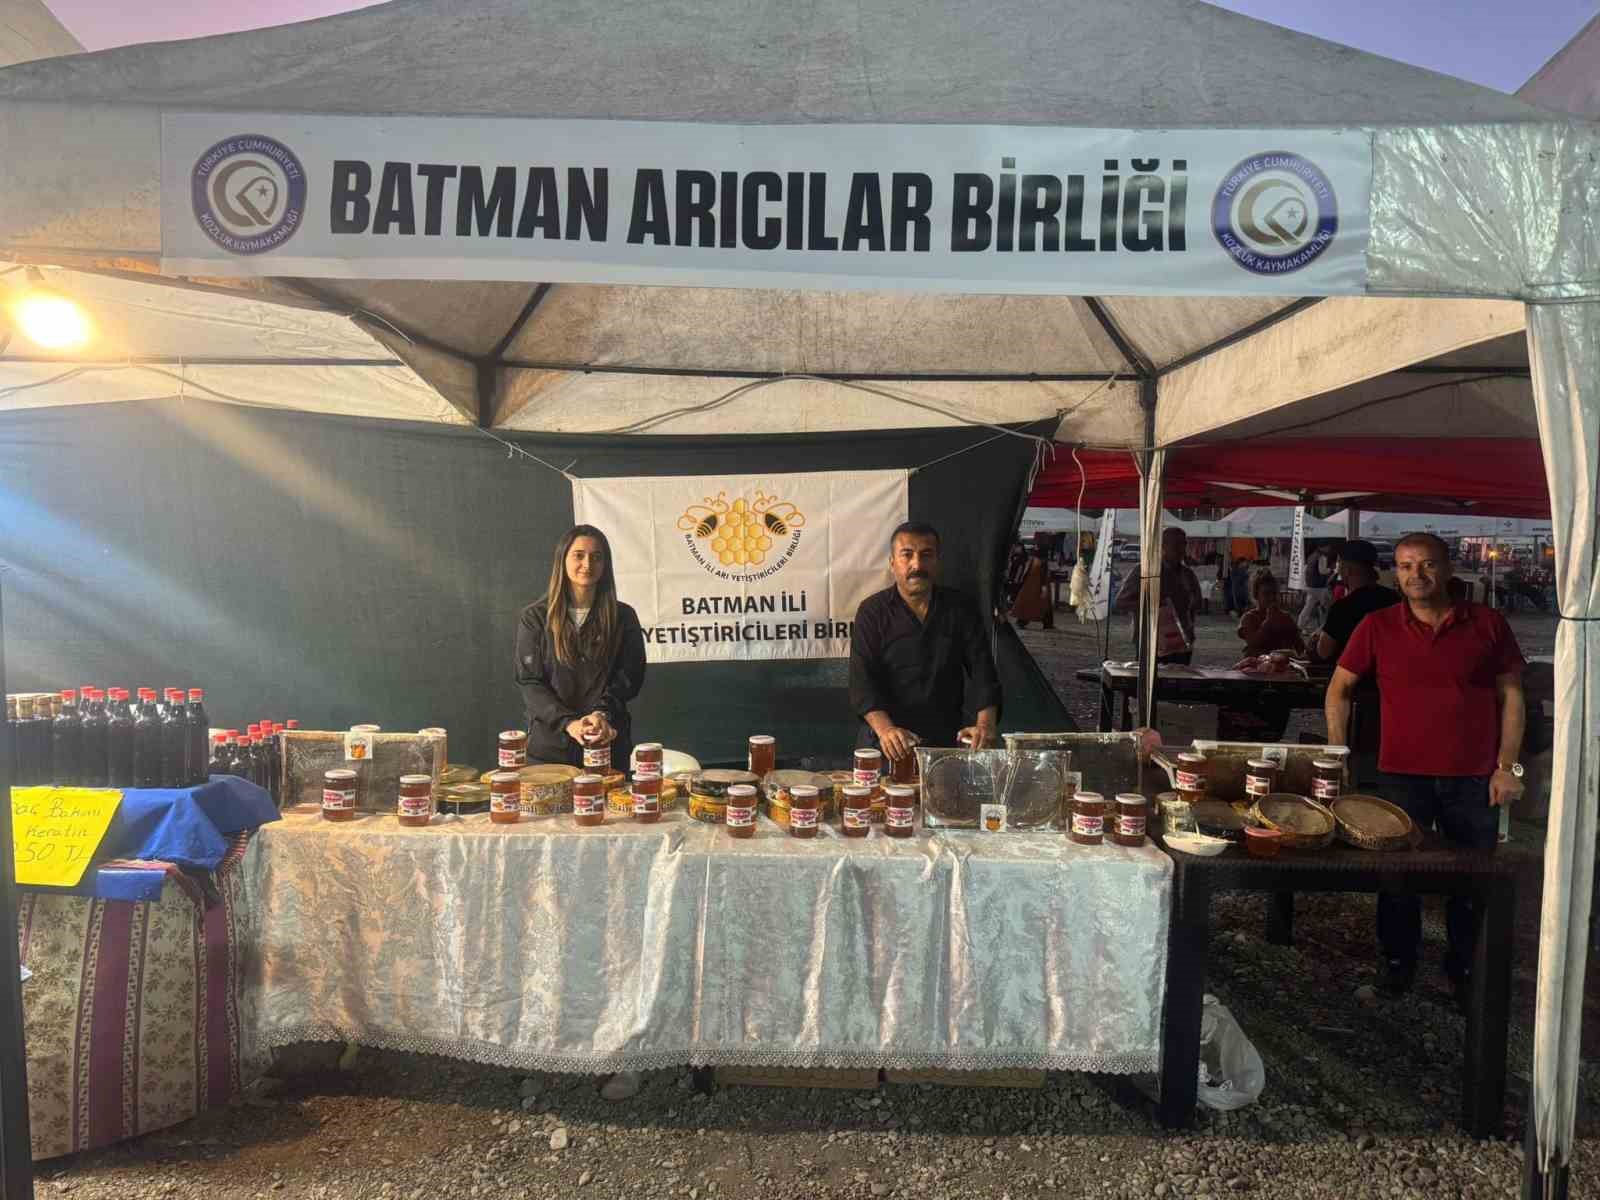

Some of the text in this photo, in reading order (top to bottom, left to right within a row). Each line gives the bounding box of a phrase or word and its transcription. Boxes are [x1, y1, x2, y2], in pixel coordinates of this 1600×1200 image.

[1221, 159, 1261, 198] TÜRKİYE
[330, 157, 1188, 252] BATMAN ARICILAR BİRLİĞİ
[1221, 229, 1331, 272] KOZLUK KAYMAKAMLIĞI
[685, 533, 705, 566] BATMAN
[715, 570, 729, 580] ARI
[682, 590, 807, 615] BATMAN İLİ
[641, 618, 854, 647] YETİŞTİRİCİLERİ BİR
